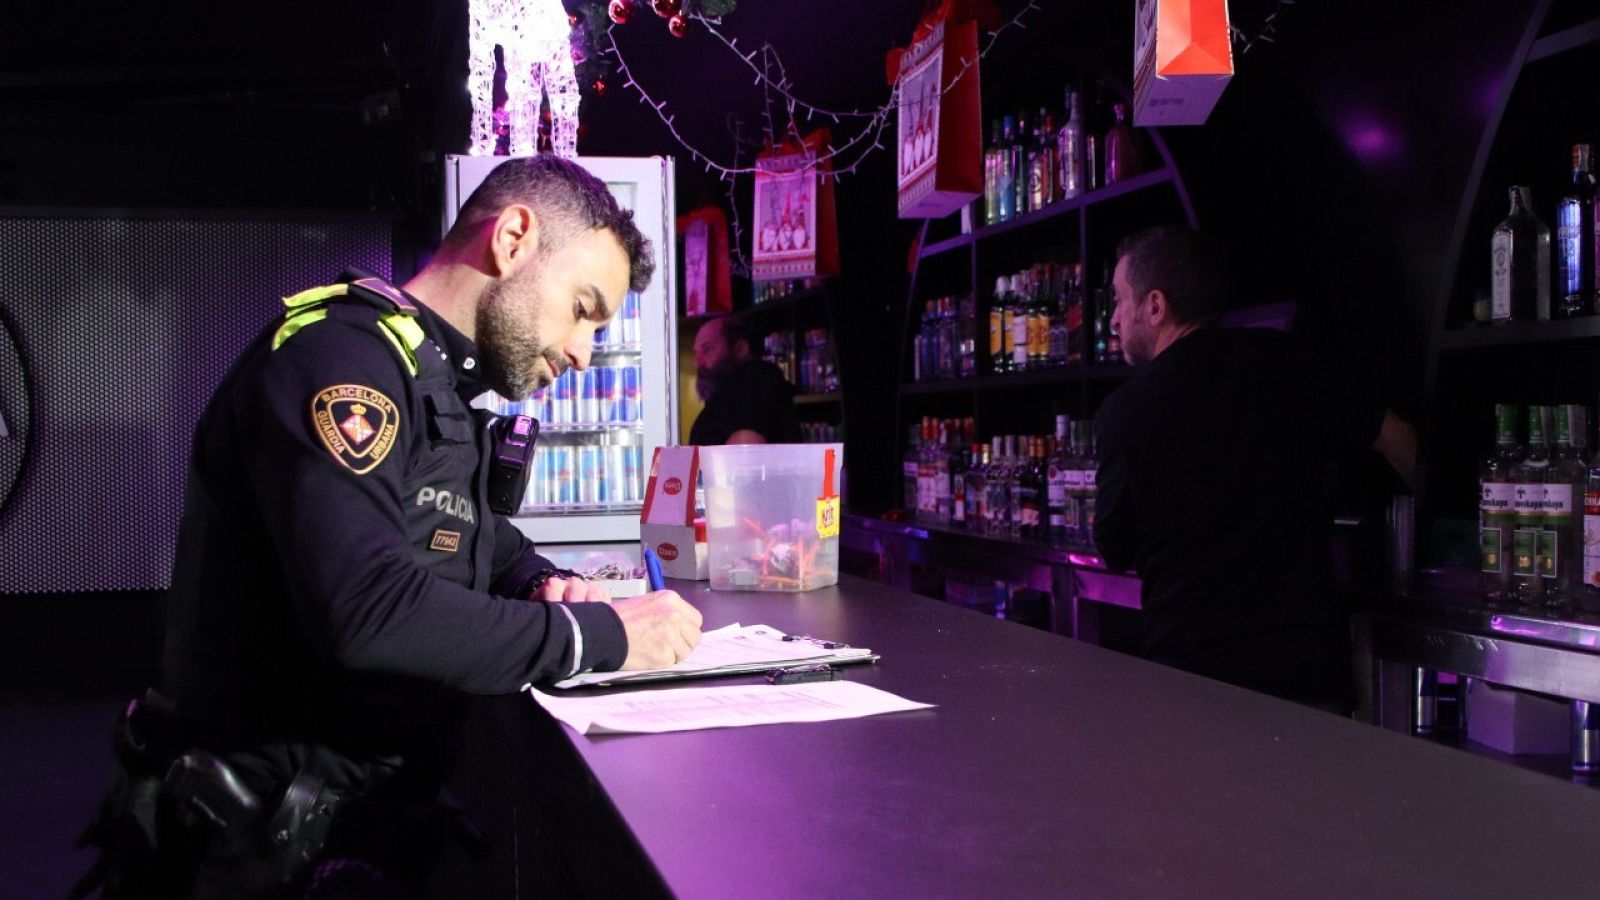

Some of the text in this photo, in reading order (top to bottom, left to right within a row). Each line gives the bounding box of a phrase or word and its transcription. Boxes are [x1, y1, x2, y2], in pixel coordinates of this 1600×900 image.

[321, 388, 392, 413] BARCELONA
[317, 410, 346, 455] GUARDIA
[369, 424, 395, 460] URBANA
[416, 486, 474, 525] POLICIA
